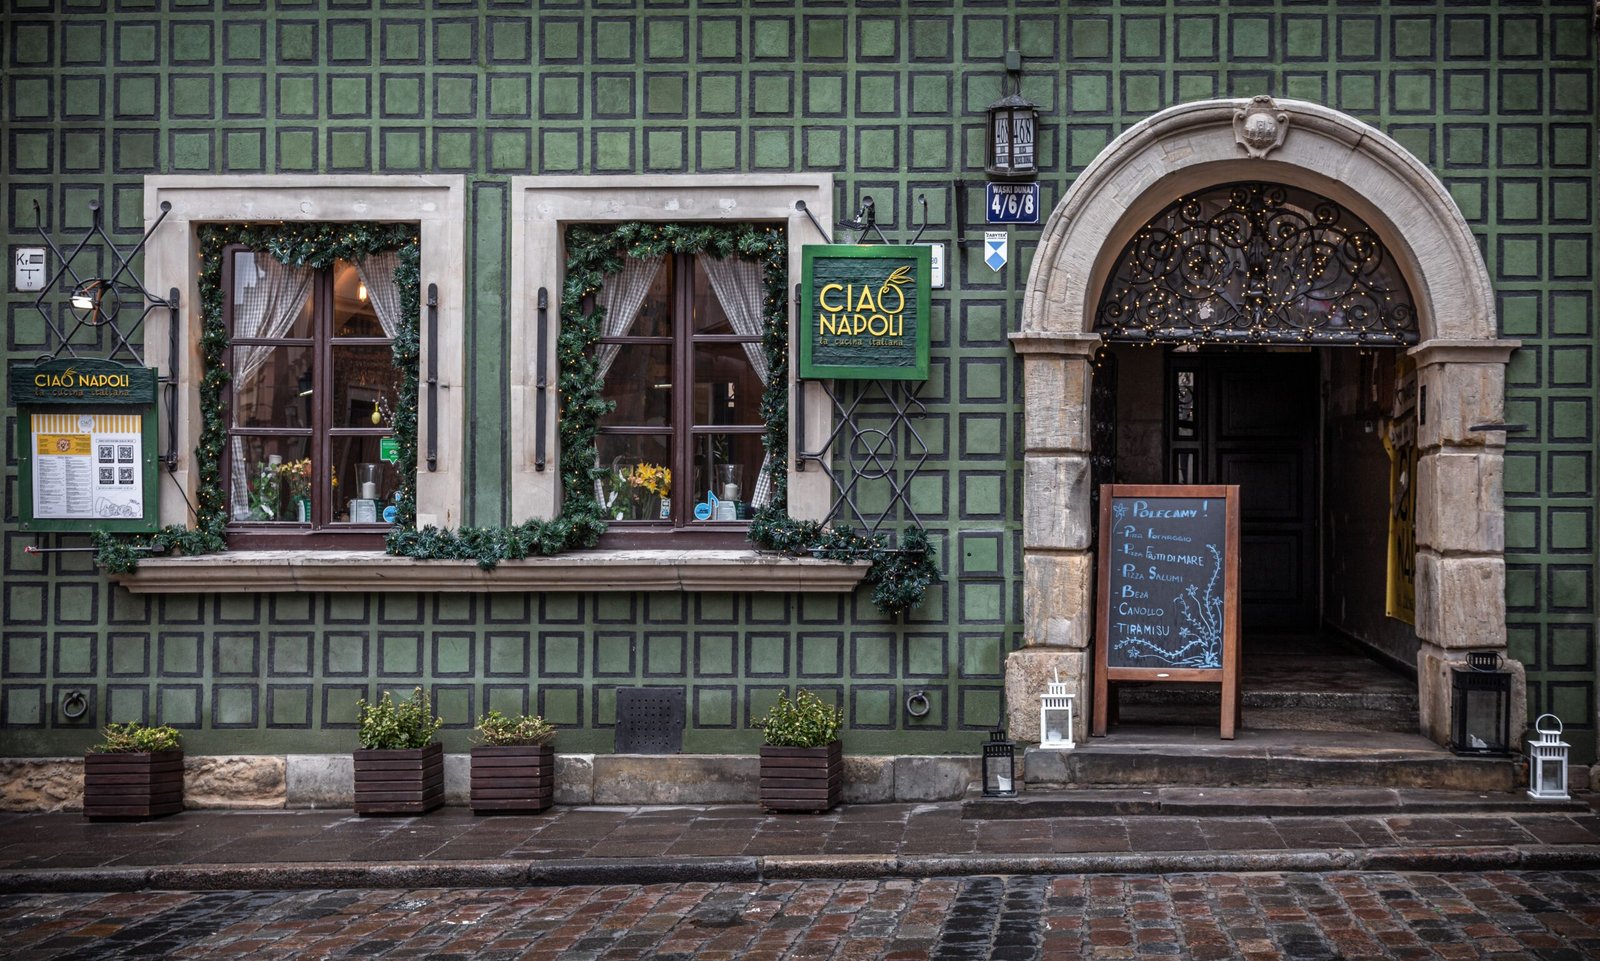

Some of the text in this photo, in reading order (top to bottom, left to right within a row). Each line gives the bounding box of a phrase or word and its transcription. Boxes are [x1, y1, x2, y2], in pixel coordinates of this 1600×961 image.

[993, 185, 1033, 195] WĄSKI DUNAJ
[992, 194, 1034, 218] 4/6/8
[820, 283, 905, 314] CIAO
[820, 314, 903, 336] NAPOLI
[819, 336, 828, 345] la
[869, 337, 903, 346] italiana
[35, 374, 129, 388] CIAO NAPOLI
[52, 389, 84, 397] cucina
[91, 388, 129, 397] italiana
[1133, 500, 1198, 518] POLECAMY
[1177, 555, 1205, 567] MARE
[1149, 566, 1183, 583] SALUMI
[1117, 622, 1170, 636] TIRAMISU
